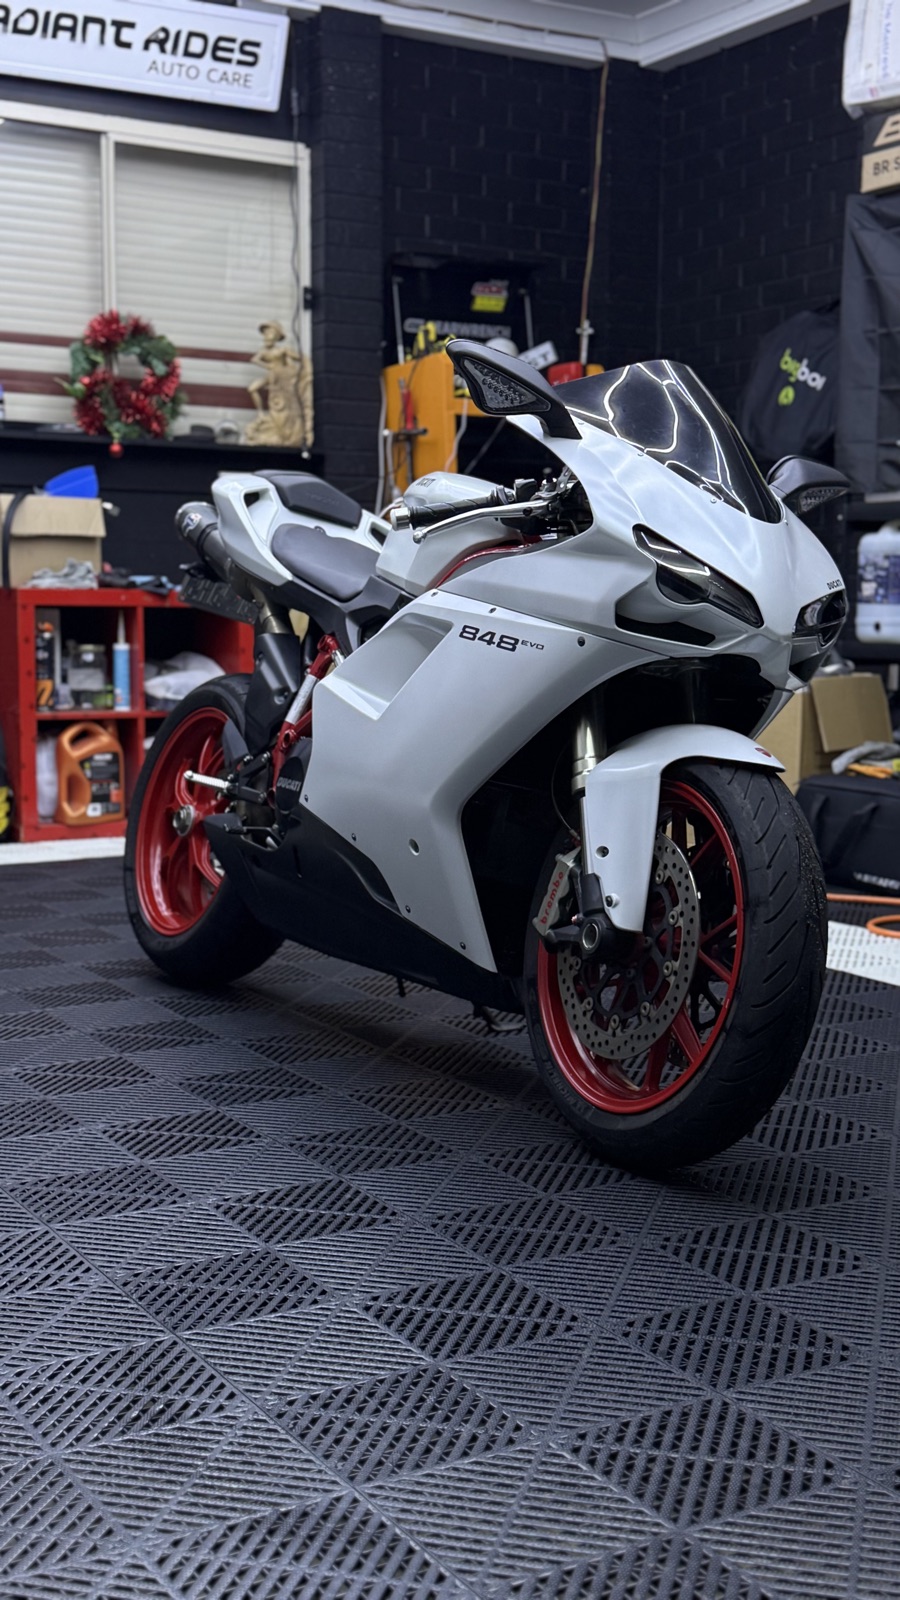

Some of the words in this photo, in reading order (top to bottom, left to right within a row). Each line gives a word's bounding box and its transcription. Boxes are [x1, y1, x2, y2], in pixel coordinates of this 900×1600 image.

[143, 26, 261, 67] RIDES
[147, 60, 200, 80] AUTO
[206, 68, 254, 89] CARE
[459, 624, 520, 652] 848
[520, 639, 545, 651] EVO
[276, 776, 302, 792] DUCATI
[540, 871, 564, 925] brembo
